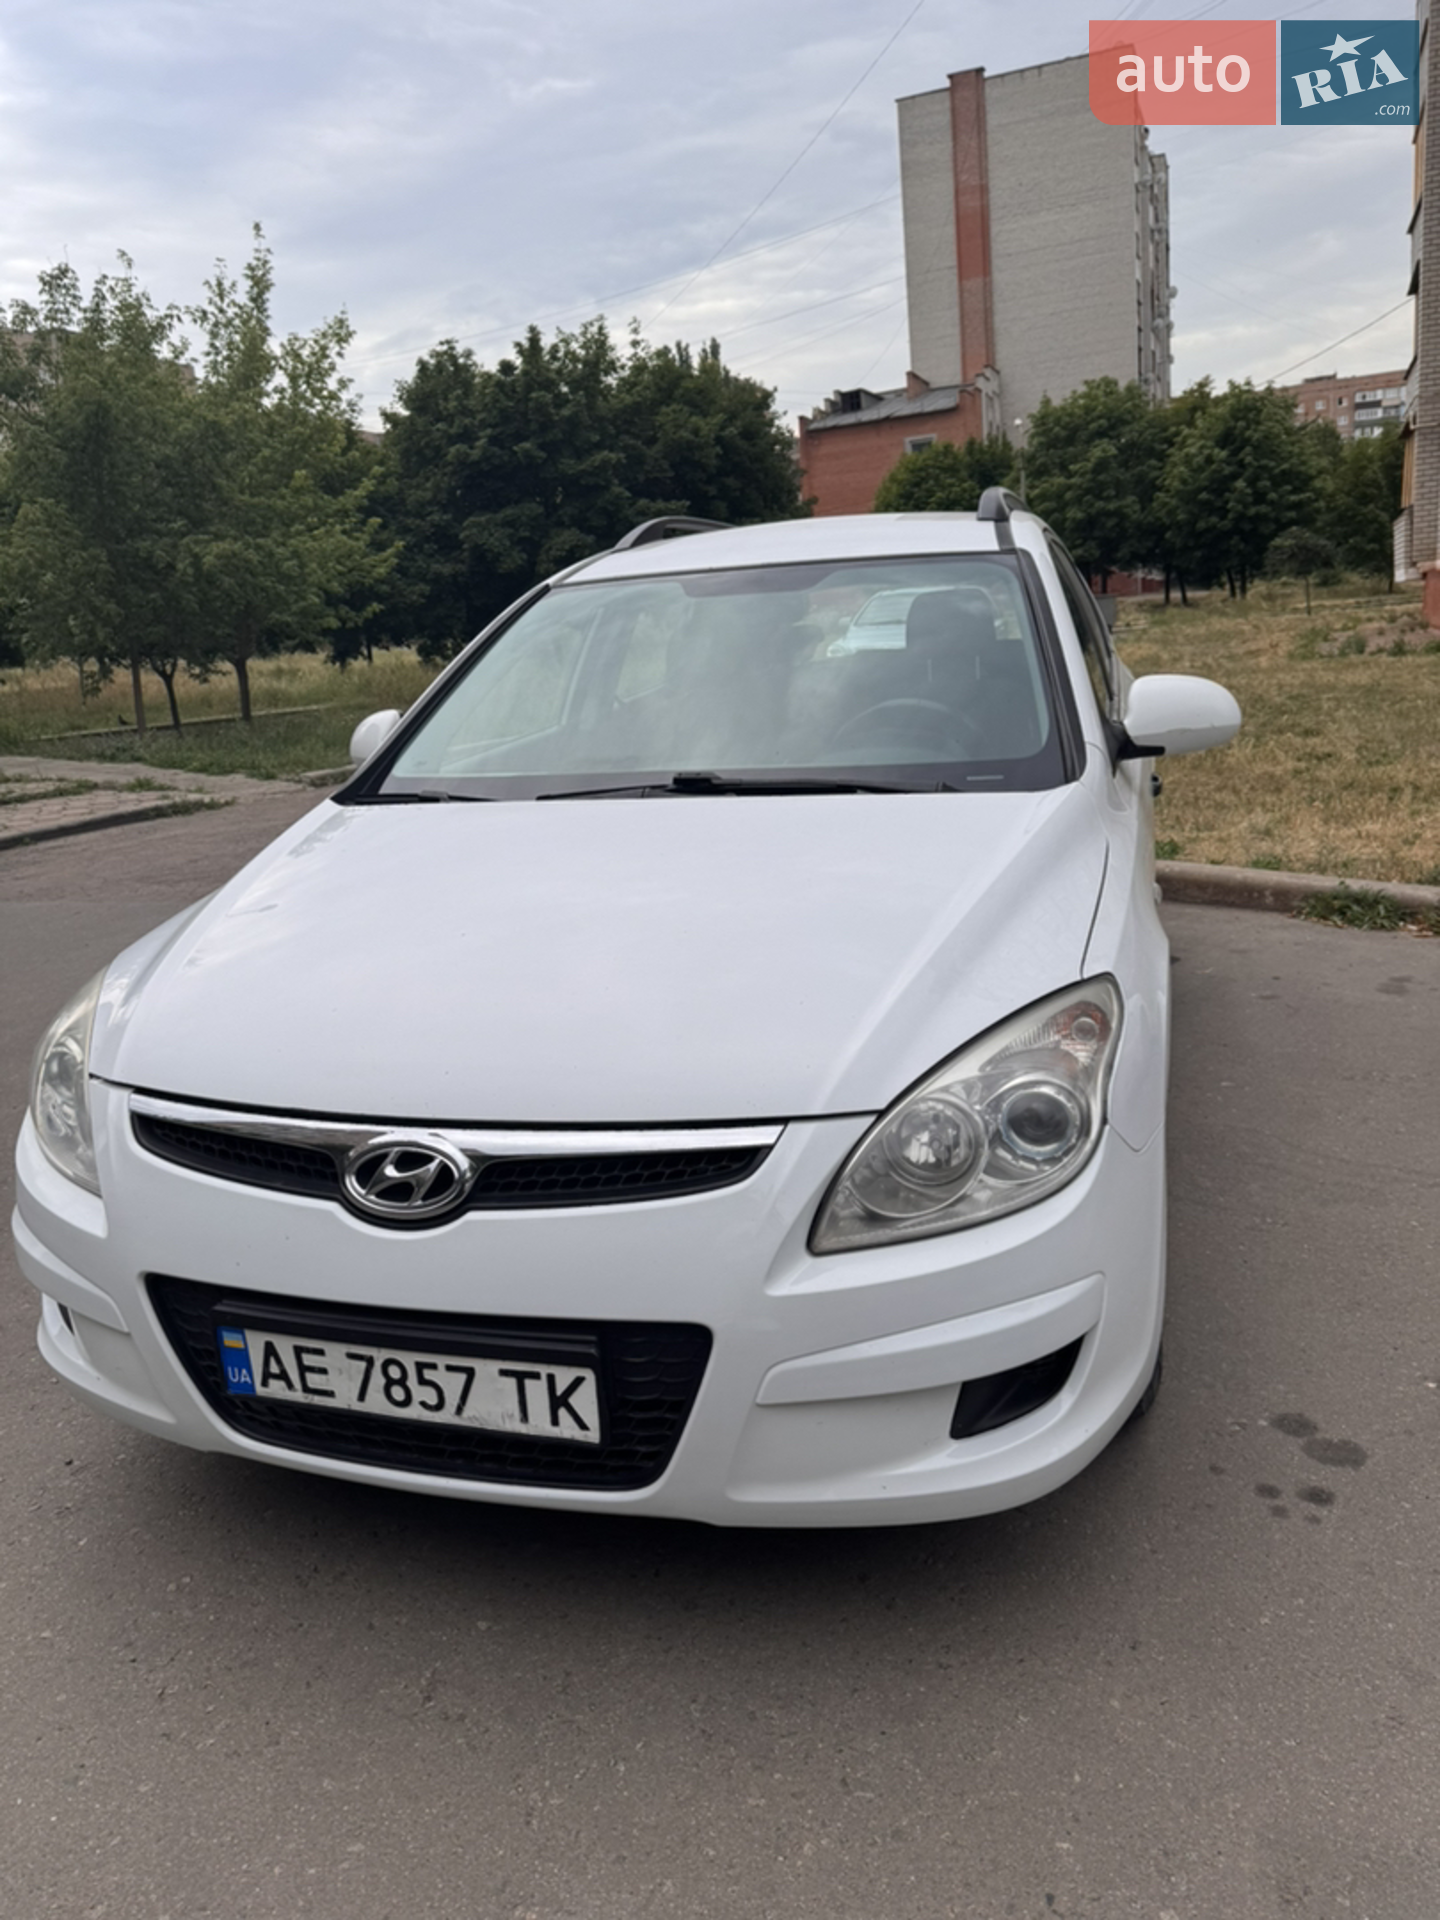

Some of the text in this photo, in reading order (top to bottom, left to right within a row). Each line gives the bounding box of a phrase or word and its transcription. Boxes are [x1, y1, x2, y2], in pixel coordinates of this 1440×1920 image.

[228, 1366, 252, 1384] UA
[260, 1340, 590, 1431] AE 7857 TK
